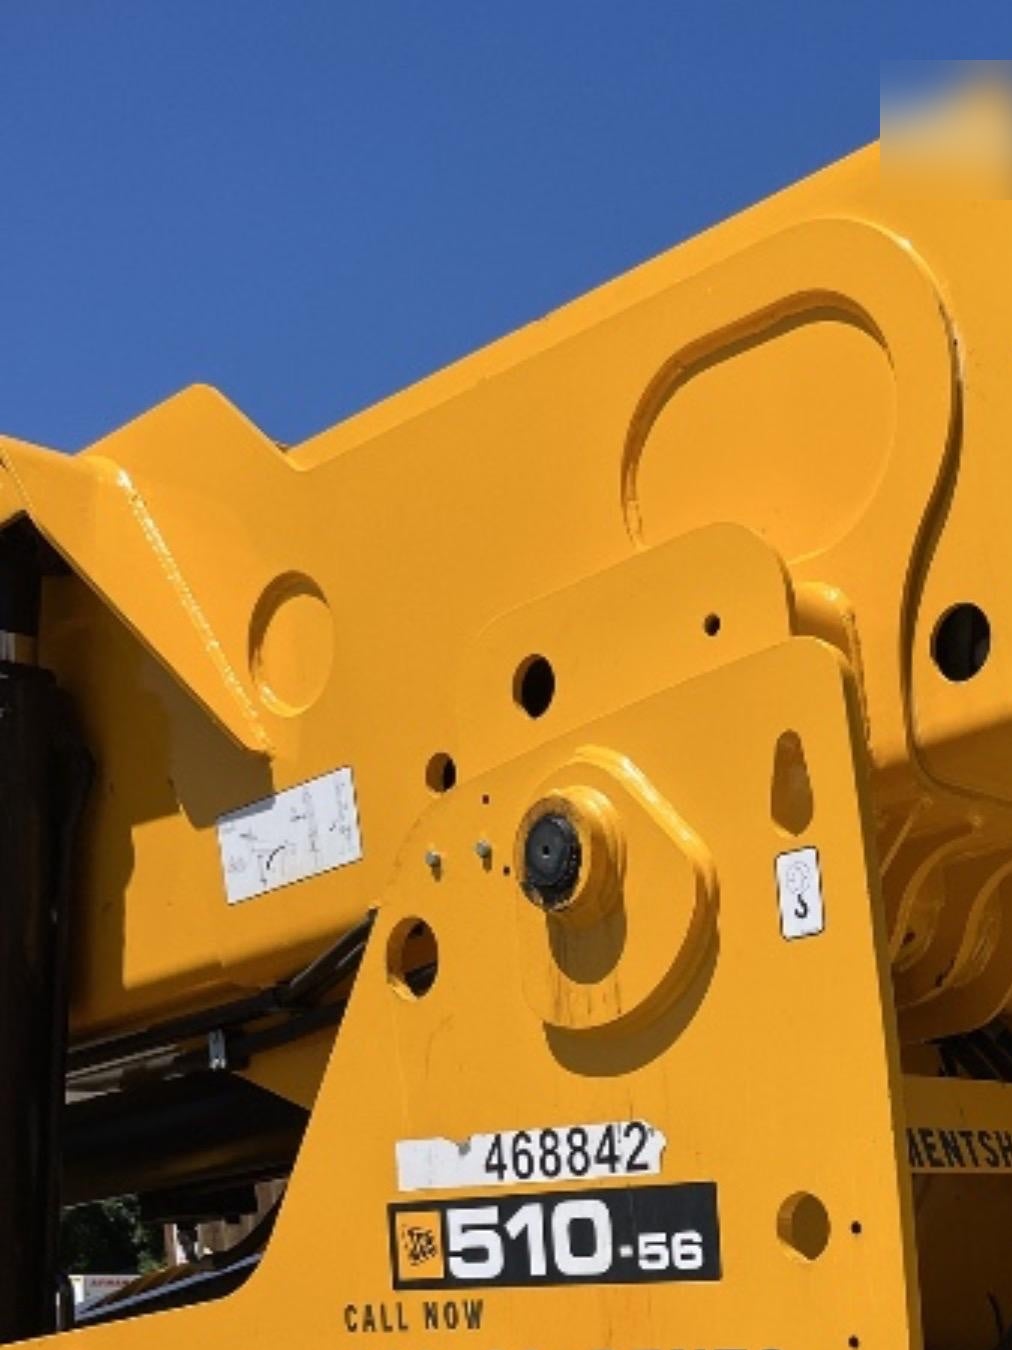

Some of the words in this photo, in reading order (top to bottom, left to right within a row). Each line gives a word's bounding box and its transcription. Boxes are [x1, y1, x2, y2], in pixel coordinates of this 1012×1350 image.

[484, 1121, 650, 1181] 468842
[446, 1199, 703, 1280] 510-56
[344, 1301, 409, 1332] CALL
[425, 1299, 484, 1330] NOW
